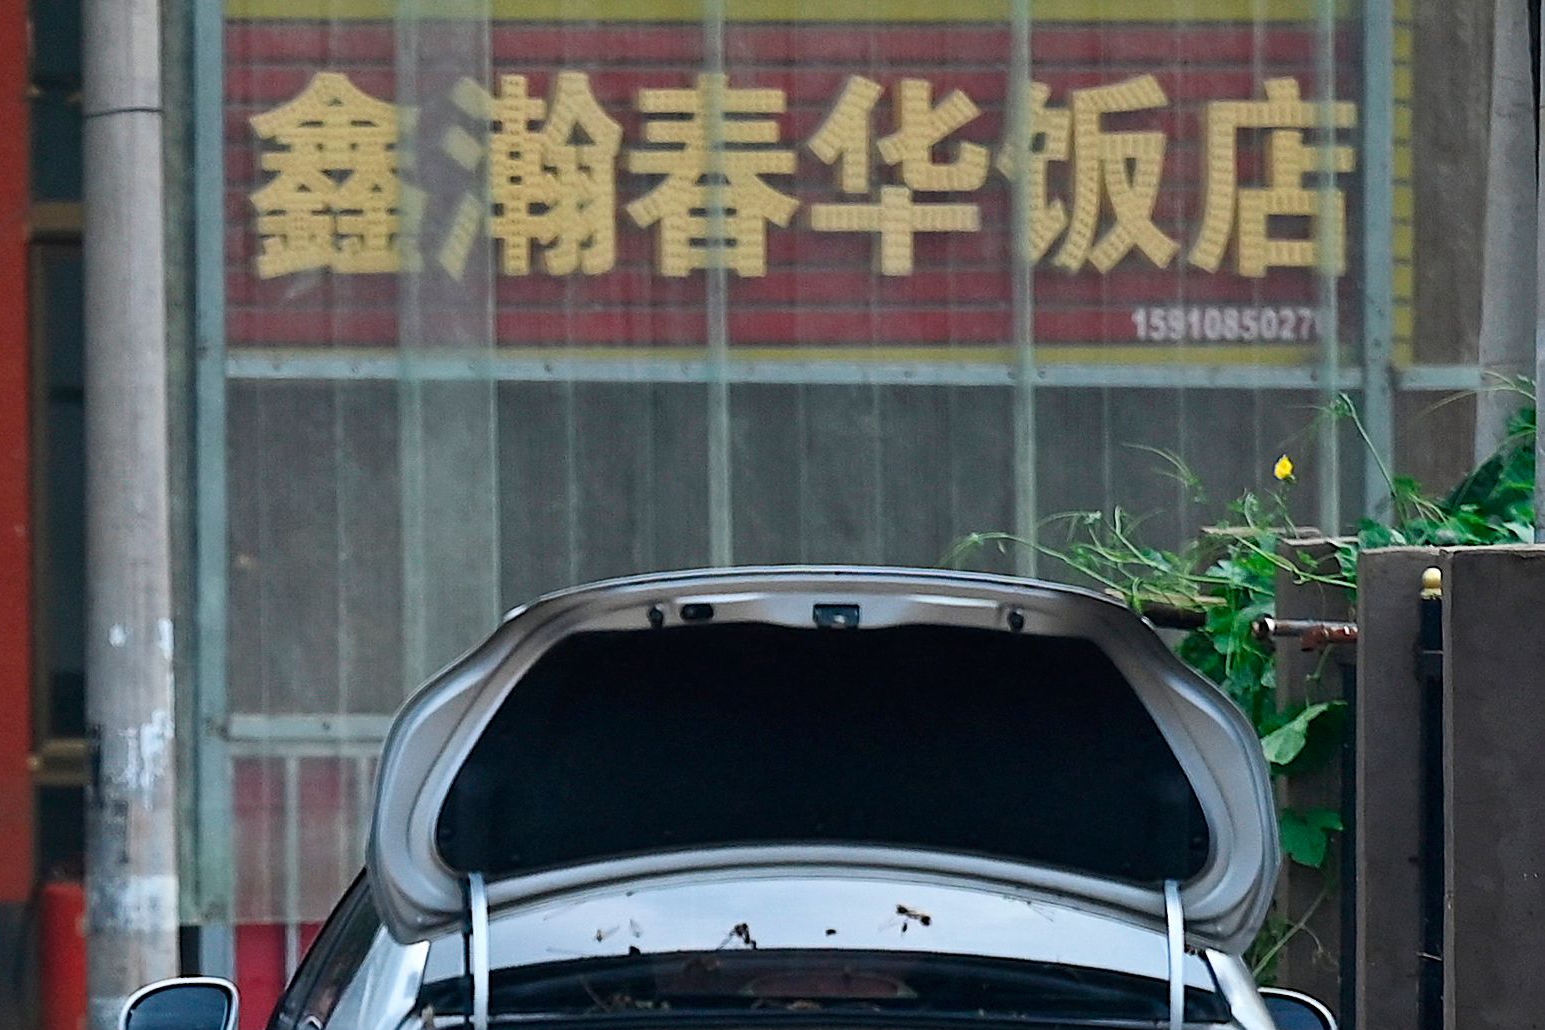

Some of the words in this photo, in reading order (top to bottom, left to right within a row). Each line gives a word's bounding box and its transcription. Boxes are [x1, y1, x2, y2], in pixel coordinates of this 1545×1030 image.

[250, 71, 1356, 279] 鑫瀚春华饭店
[1131, 306, 1332, 340] 1591085027
